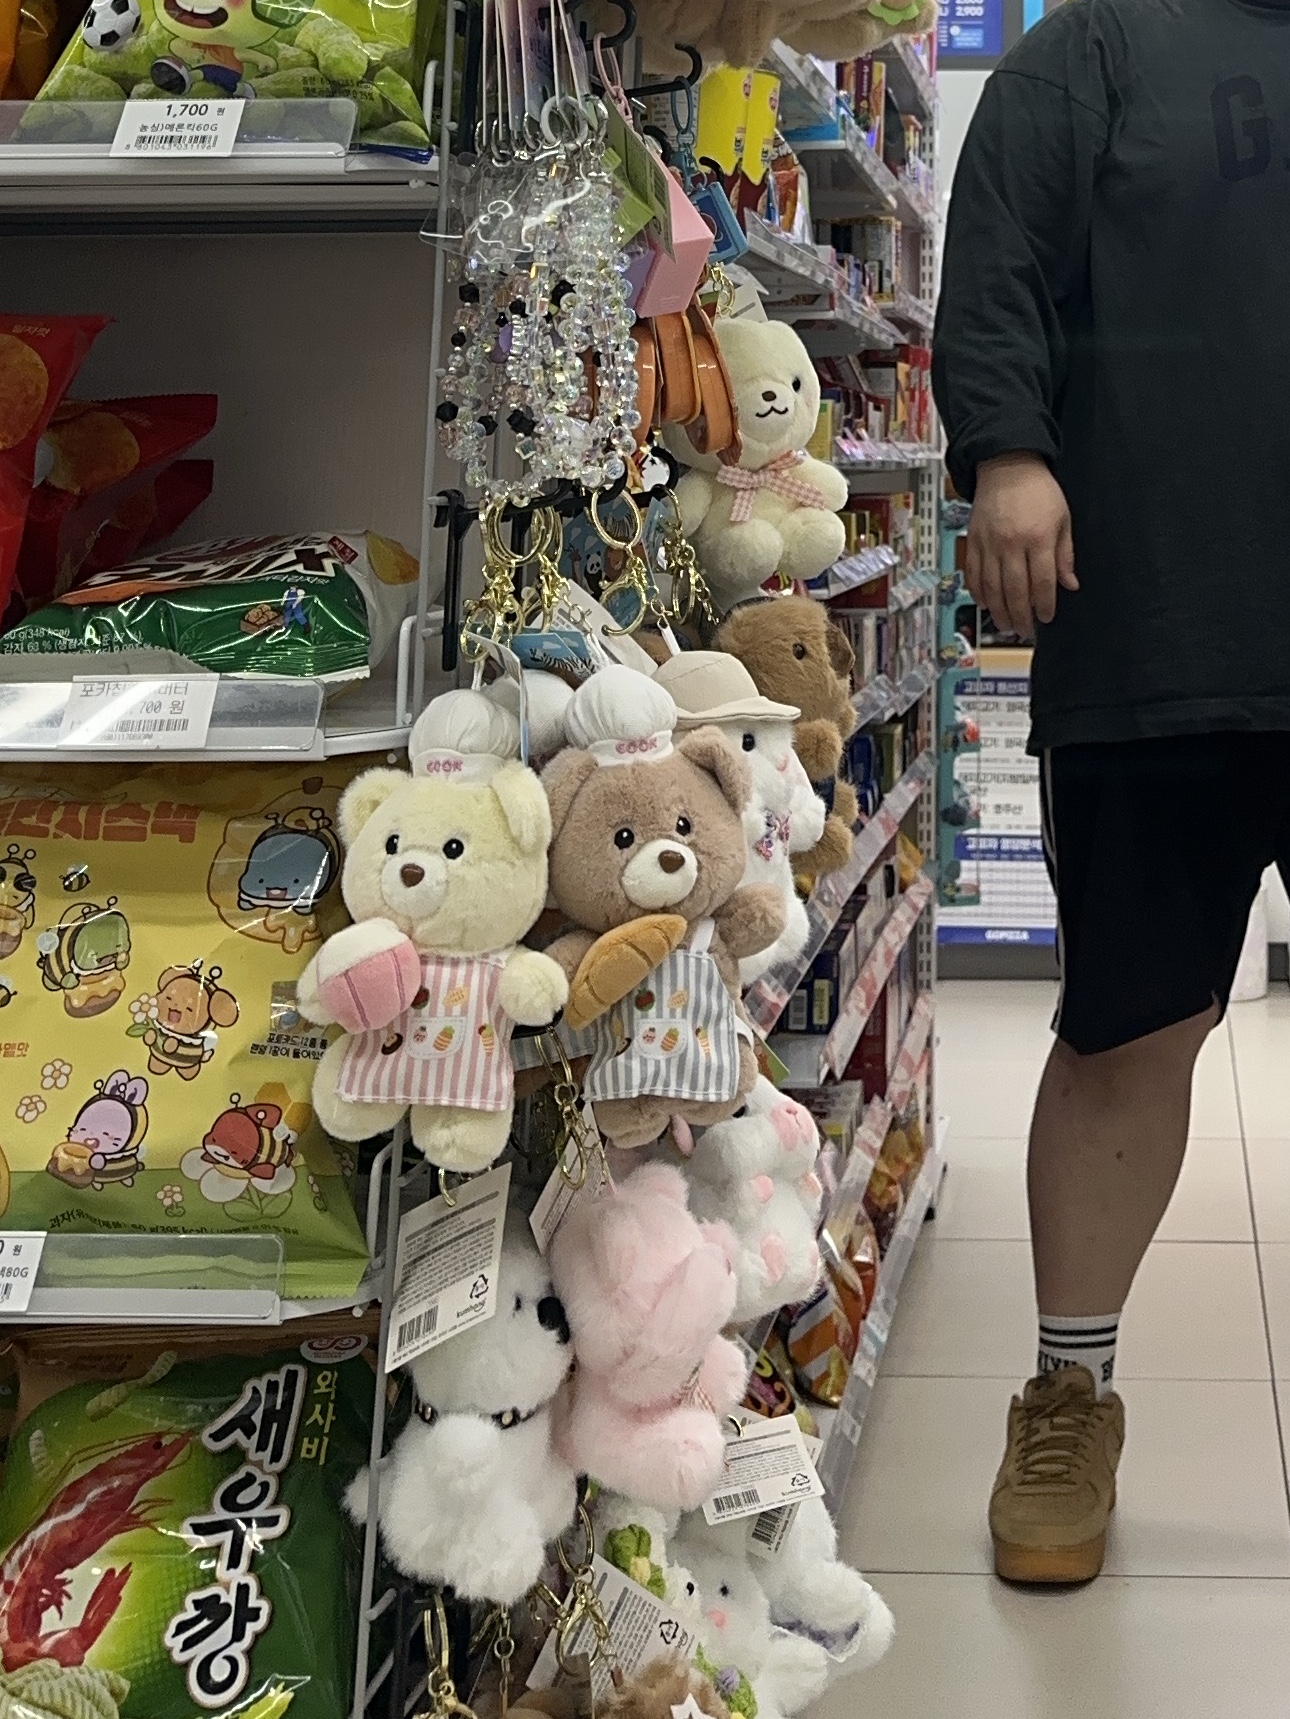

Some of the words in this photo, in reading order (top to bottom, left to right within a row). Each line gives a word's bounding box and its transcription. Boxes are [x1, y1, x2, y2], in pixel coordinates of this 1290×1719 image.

[166, 104, 209, 118] 1,700
[169, 700, 185, 715] 원
[615, 737, 658, 755] COOK
[426, 759, 464, 774] COOK
[0, 800, 200, 844] 단지스낵
[168, 1364, 305, 1707] 새우깡
